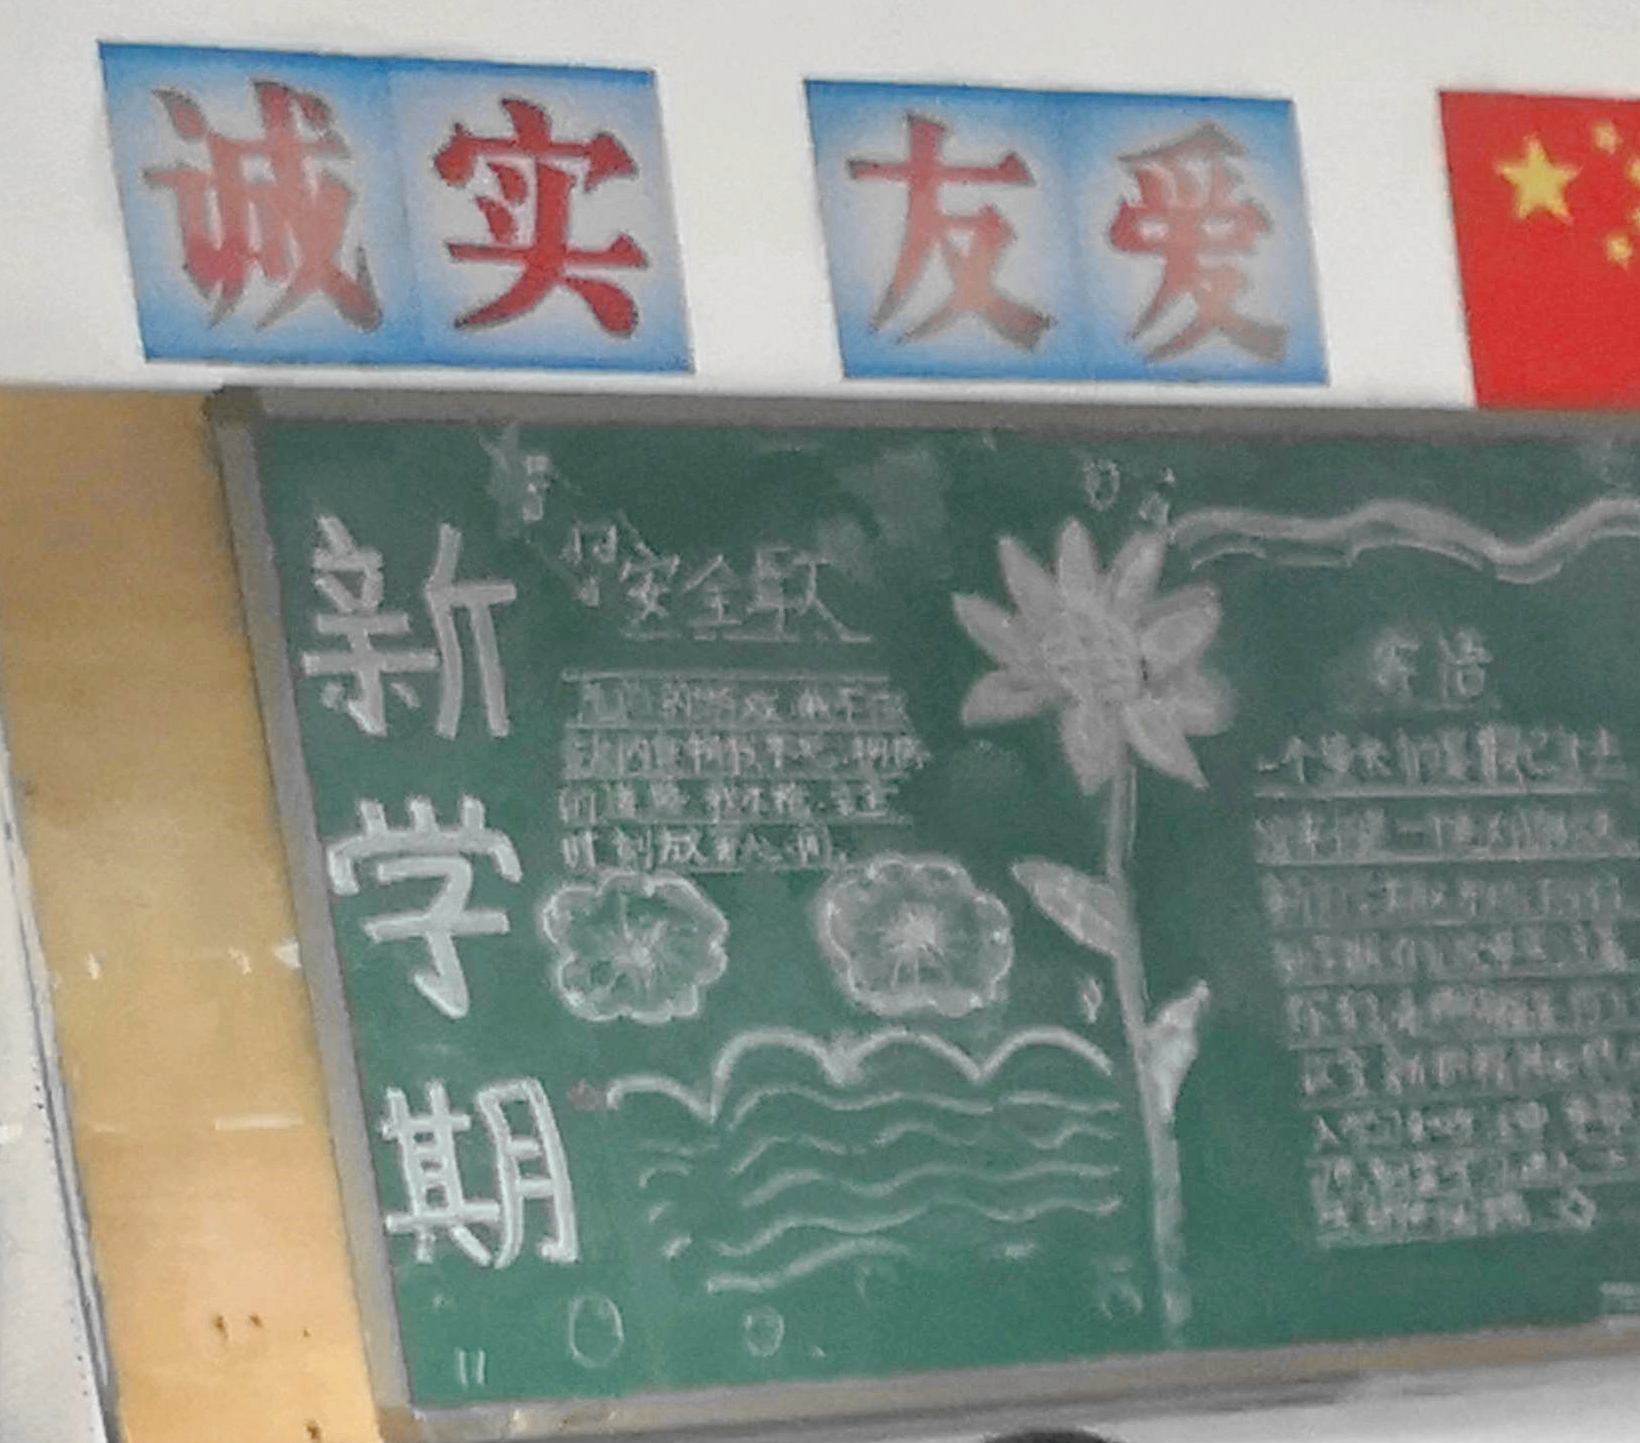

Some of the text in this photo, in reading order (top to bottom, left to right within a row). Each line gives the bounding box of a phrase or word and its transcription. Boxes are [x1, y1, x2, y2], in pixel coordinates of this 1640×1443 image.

[146, 80, 650, 338] 诚实
[848, 112, 1288, 362] 友爱
[302, 515, 581, 1267] 新学期
